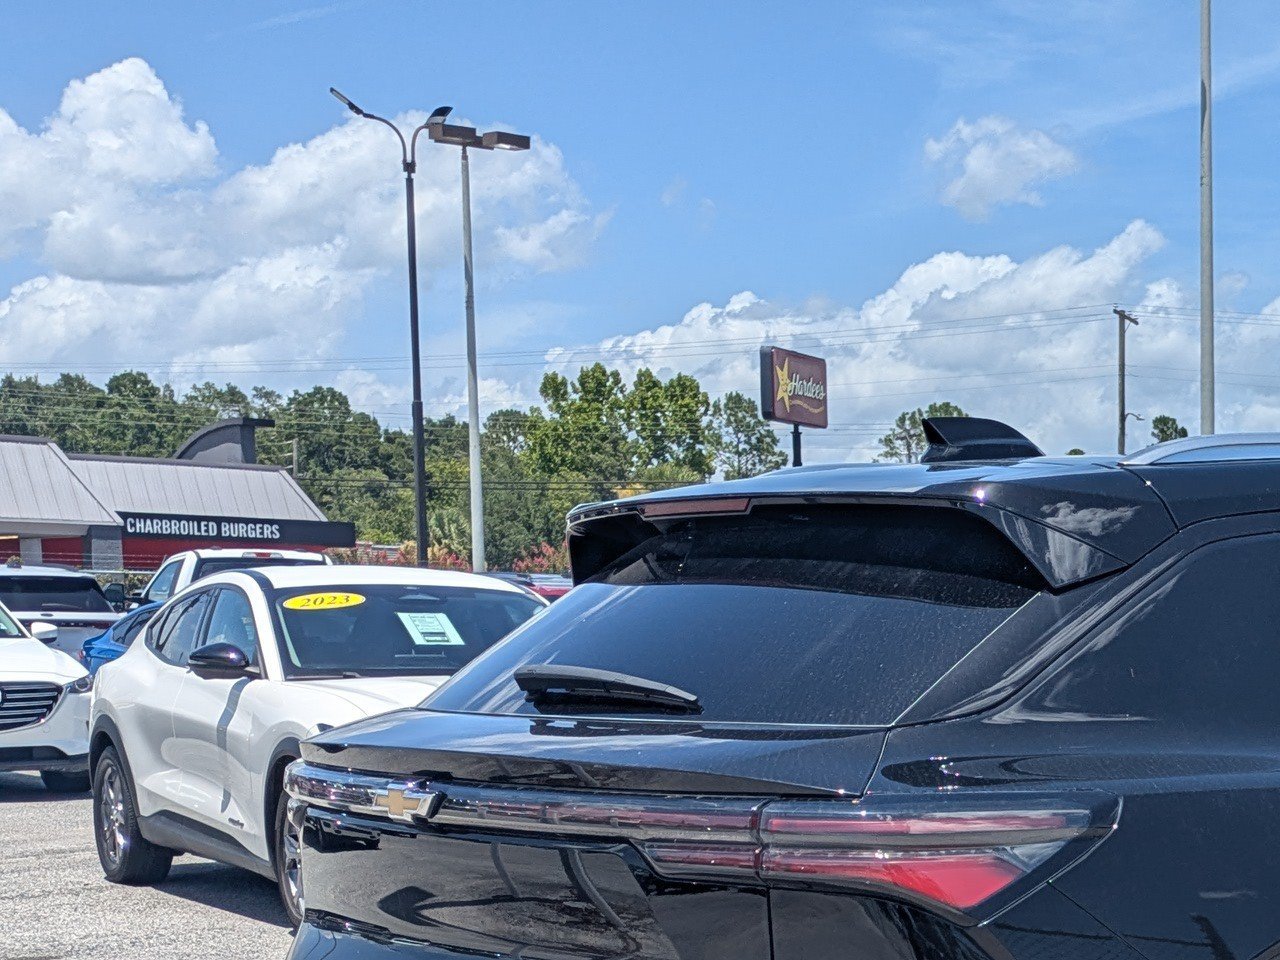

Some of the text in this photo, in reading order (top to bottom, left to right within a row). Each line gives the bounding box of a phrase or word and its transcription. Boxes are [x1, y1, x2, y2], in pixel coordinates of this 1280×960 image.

[787, 372, 826, 400] Hardee's
[126, 517, 281, 541] CHARBROILED BURGERS
[300, 595, 350, 608] 2023
